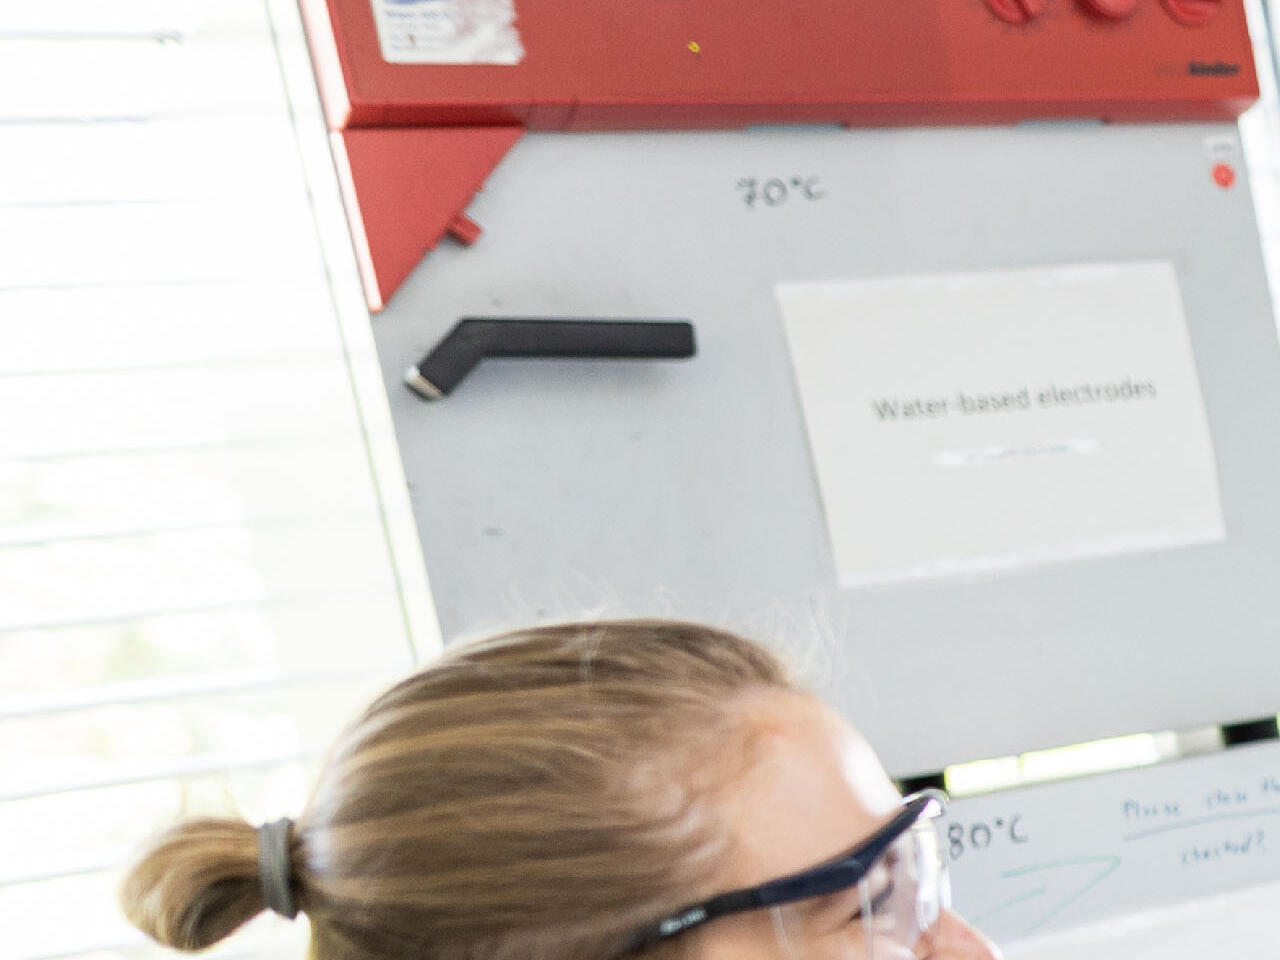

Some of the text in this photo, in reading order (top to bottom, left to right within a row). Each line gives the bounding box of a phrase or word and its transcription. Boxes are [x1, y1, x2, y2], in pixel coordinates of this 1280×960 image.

[736, 177, 829, 209] 70°C
[869, 376, 1158, 421] Water-based electrodes
[948, 813, 1029, 860] 80°C
